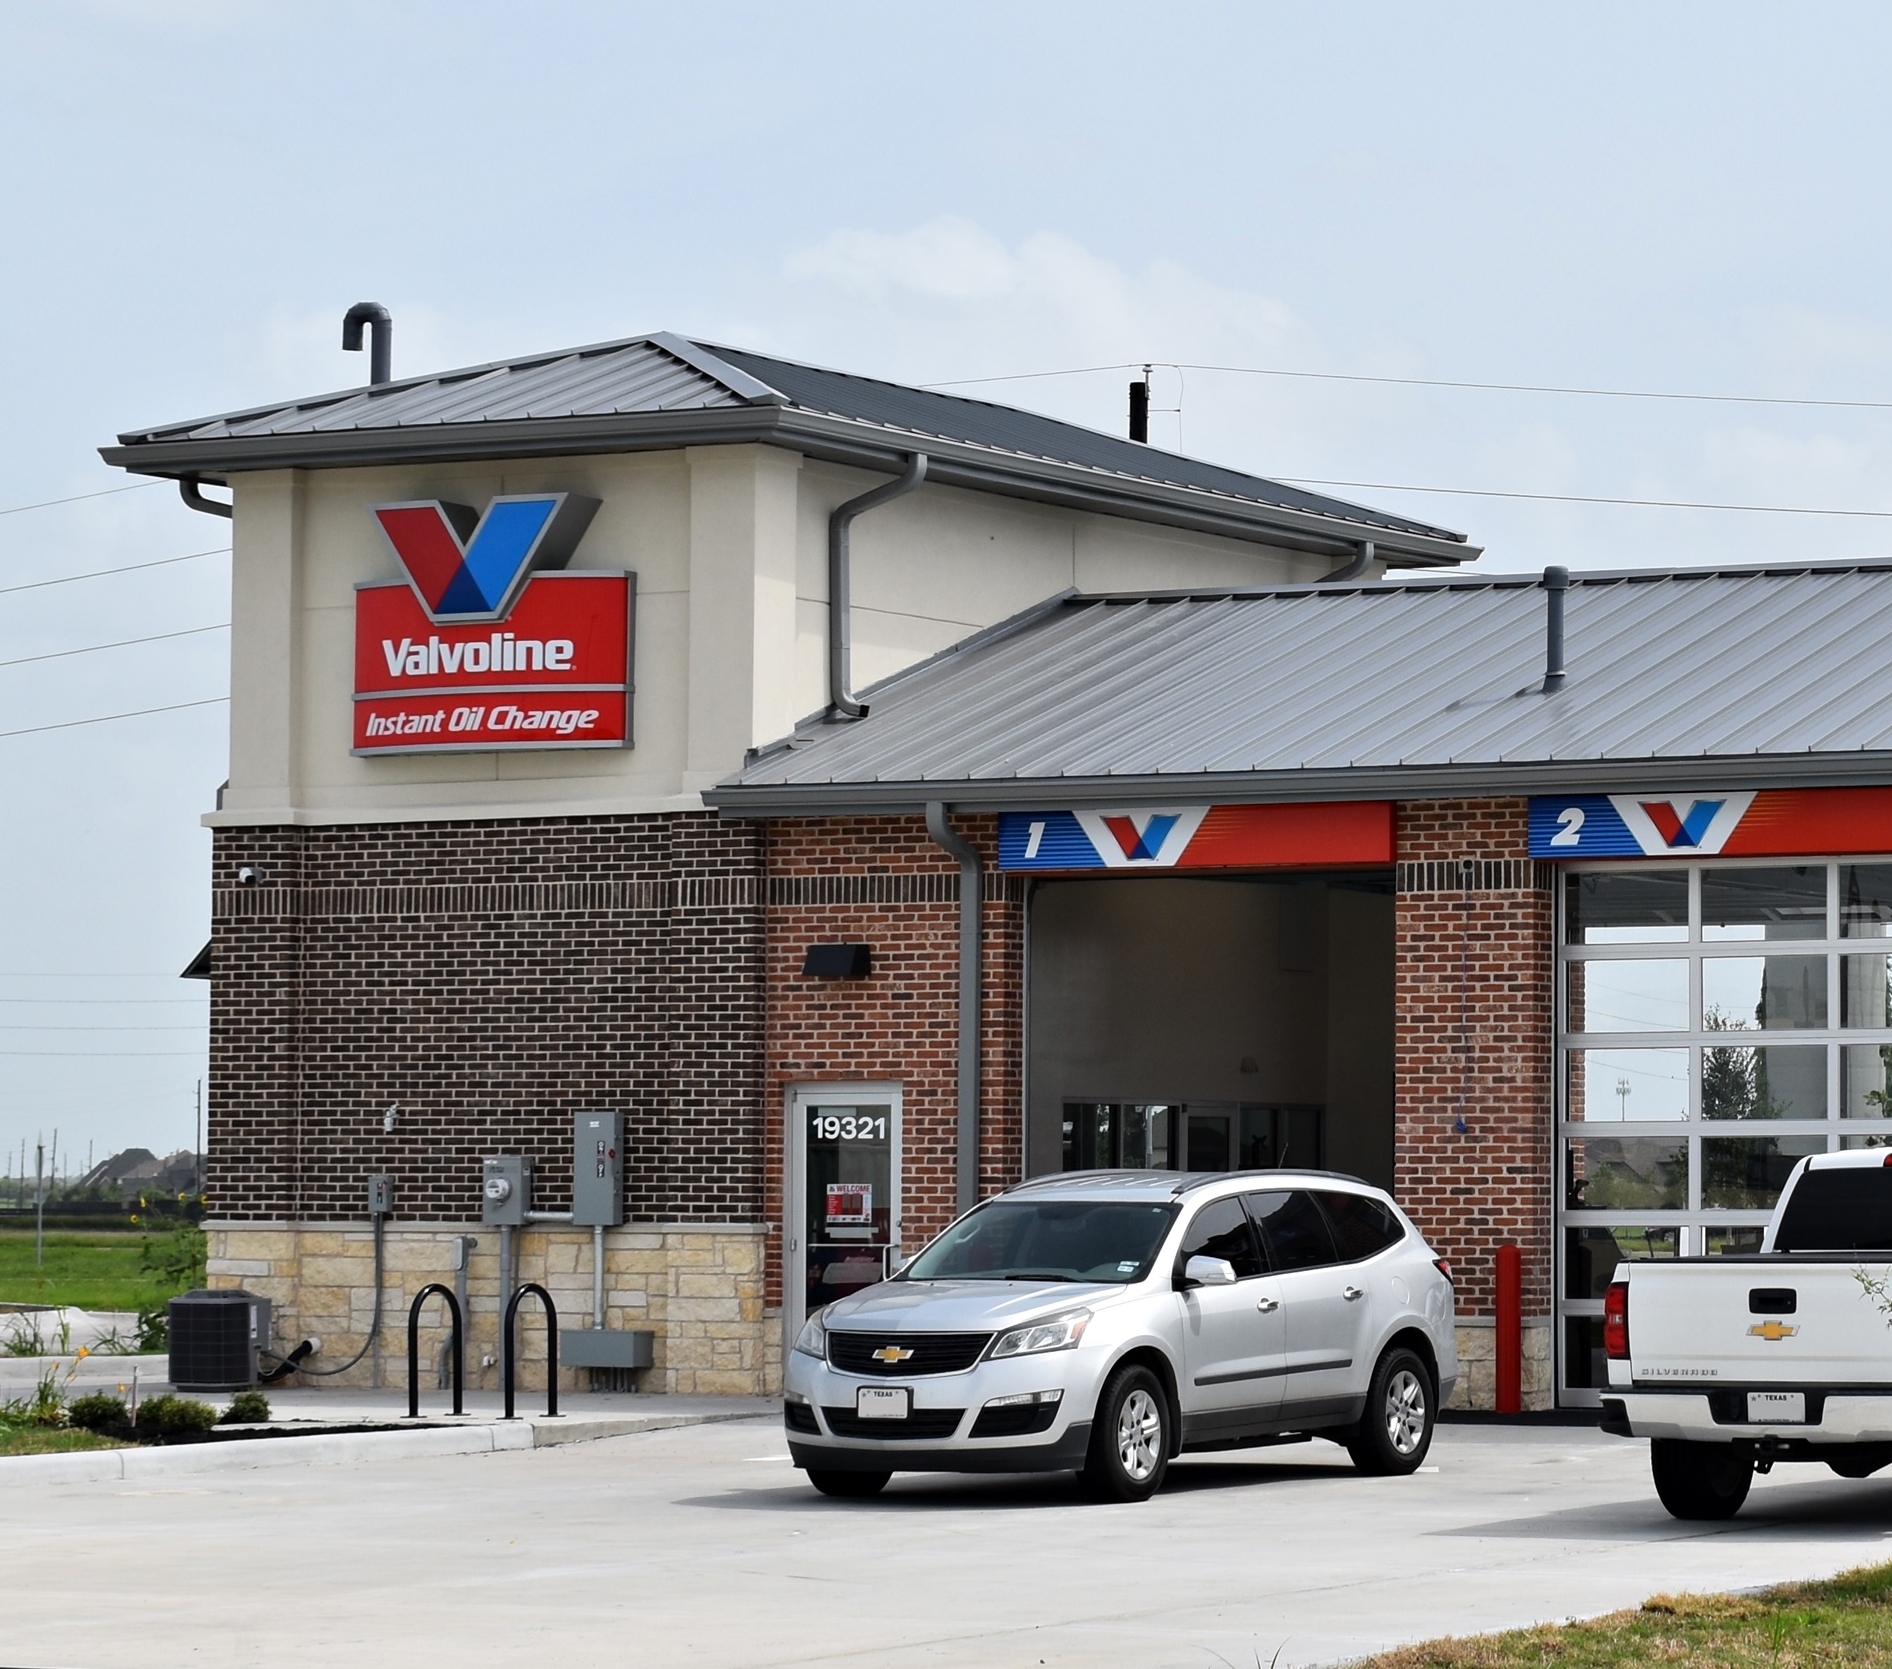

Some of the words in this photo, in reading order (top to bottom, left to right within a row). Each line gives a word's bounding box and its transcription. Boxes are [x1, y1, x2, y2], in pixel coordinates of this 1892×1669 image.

[382, 632, 575, 677] Valvoline
[365, 709, 446, 737] Instant
[449, 706, 486, 732] Oil
[487, 705, 599, 735] Change
[1024, 821, 1046, 858] 1
[1550, 807, 1585, 846] 2
[812, 1116, 886, 1140] 19321
[836, 1184, 871, 1193] WELCOME
